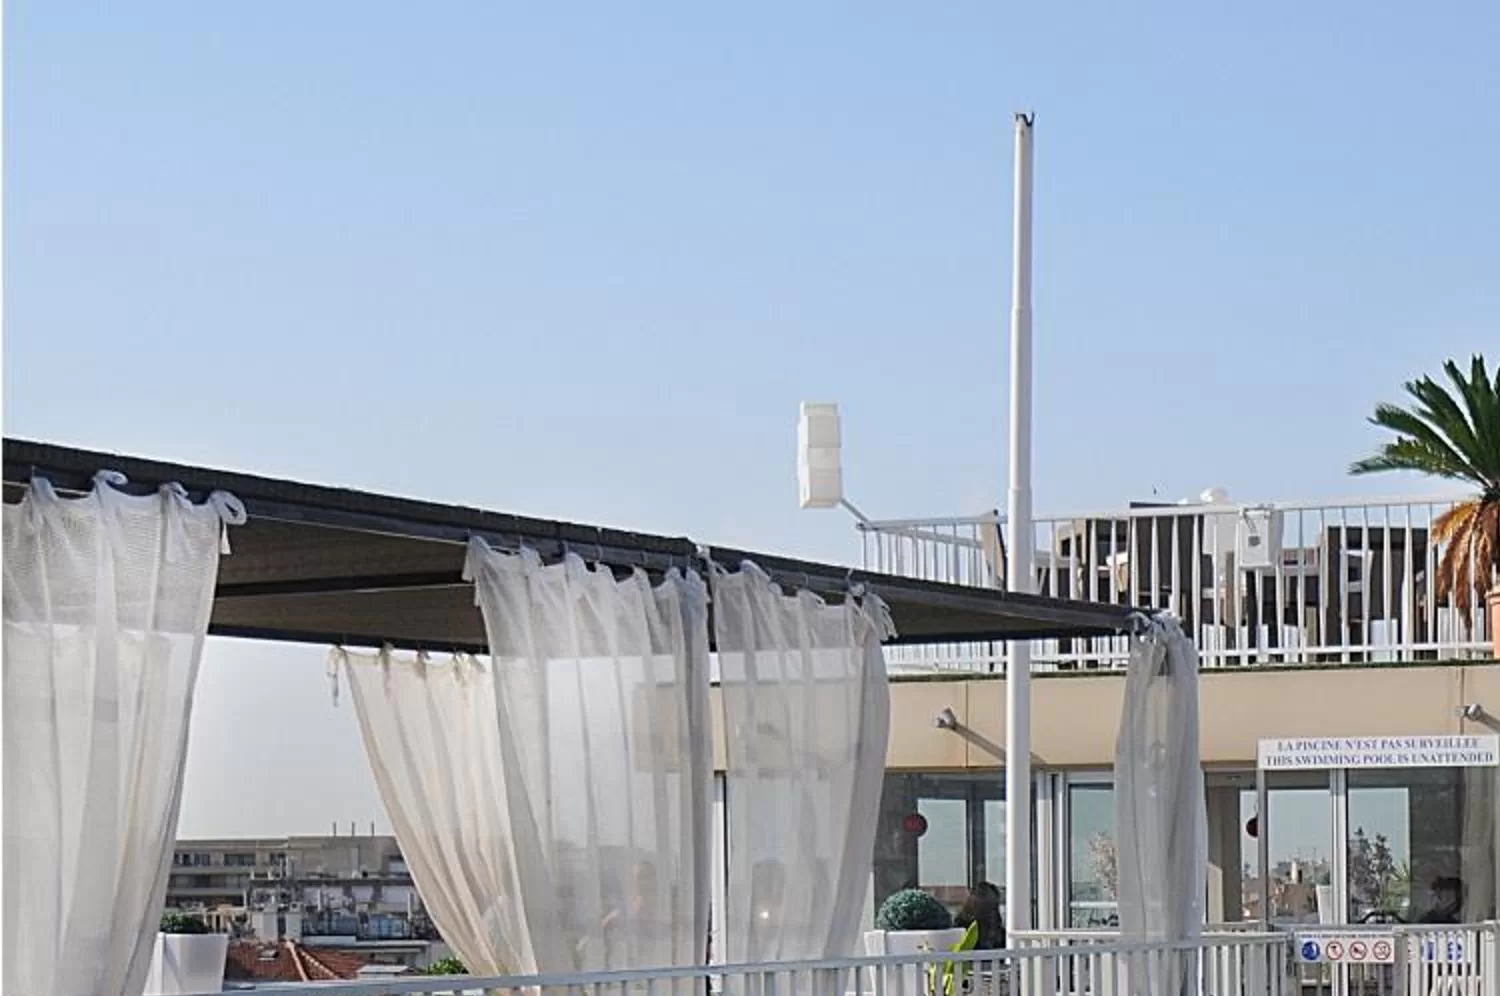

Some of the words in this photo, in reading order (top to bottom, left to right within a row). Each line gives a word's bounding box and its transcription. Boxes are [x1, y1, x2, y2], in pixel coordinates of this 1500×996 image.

[1277, 741, 1293, 752] LA
[1296, 740, 1341, 751] PISCINE
[1380, 739, 1402, 749] PAS
[1266, 755, 1293, 766] THIS
[1295, 754, 1361, 765] SWIMMING
[1363, 753, 1395, 764] POOL
[1411, 751, 1494, 763] UNATTENDED
